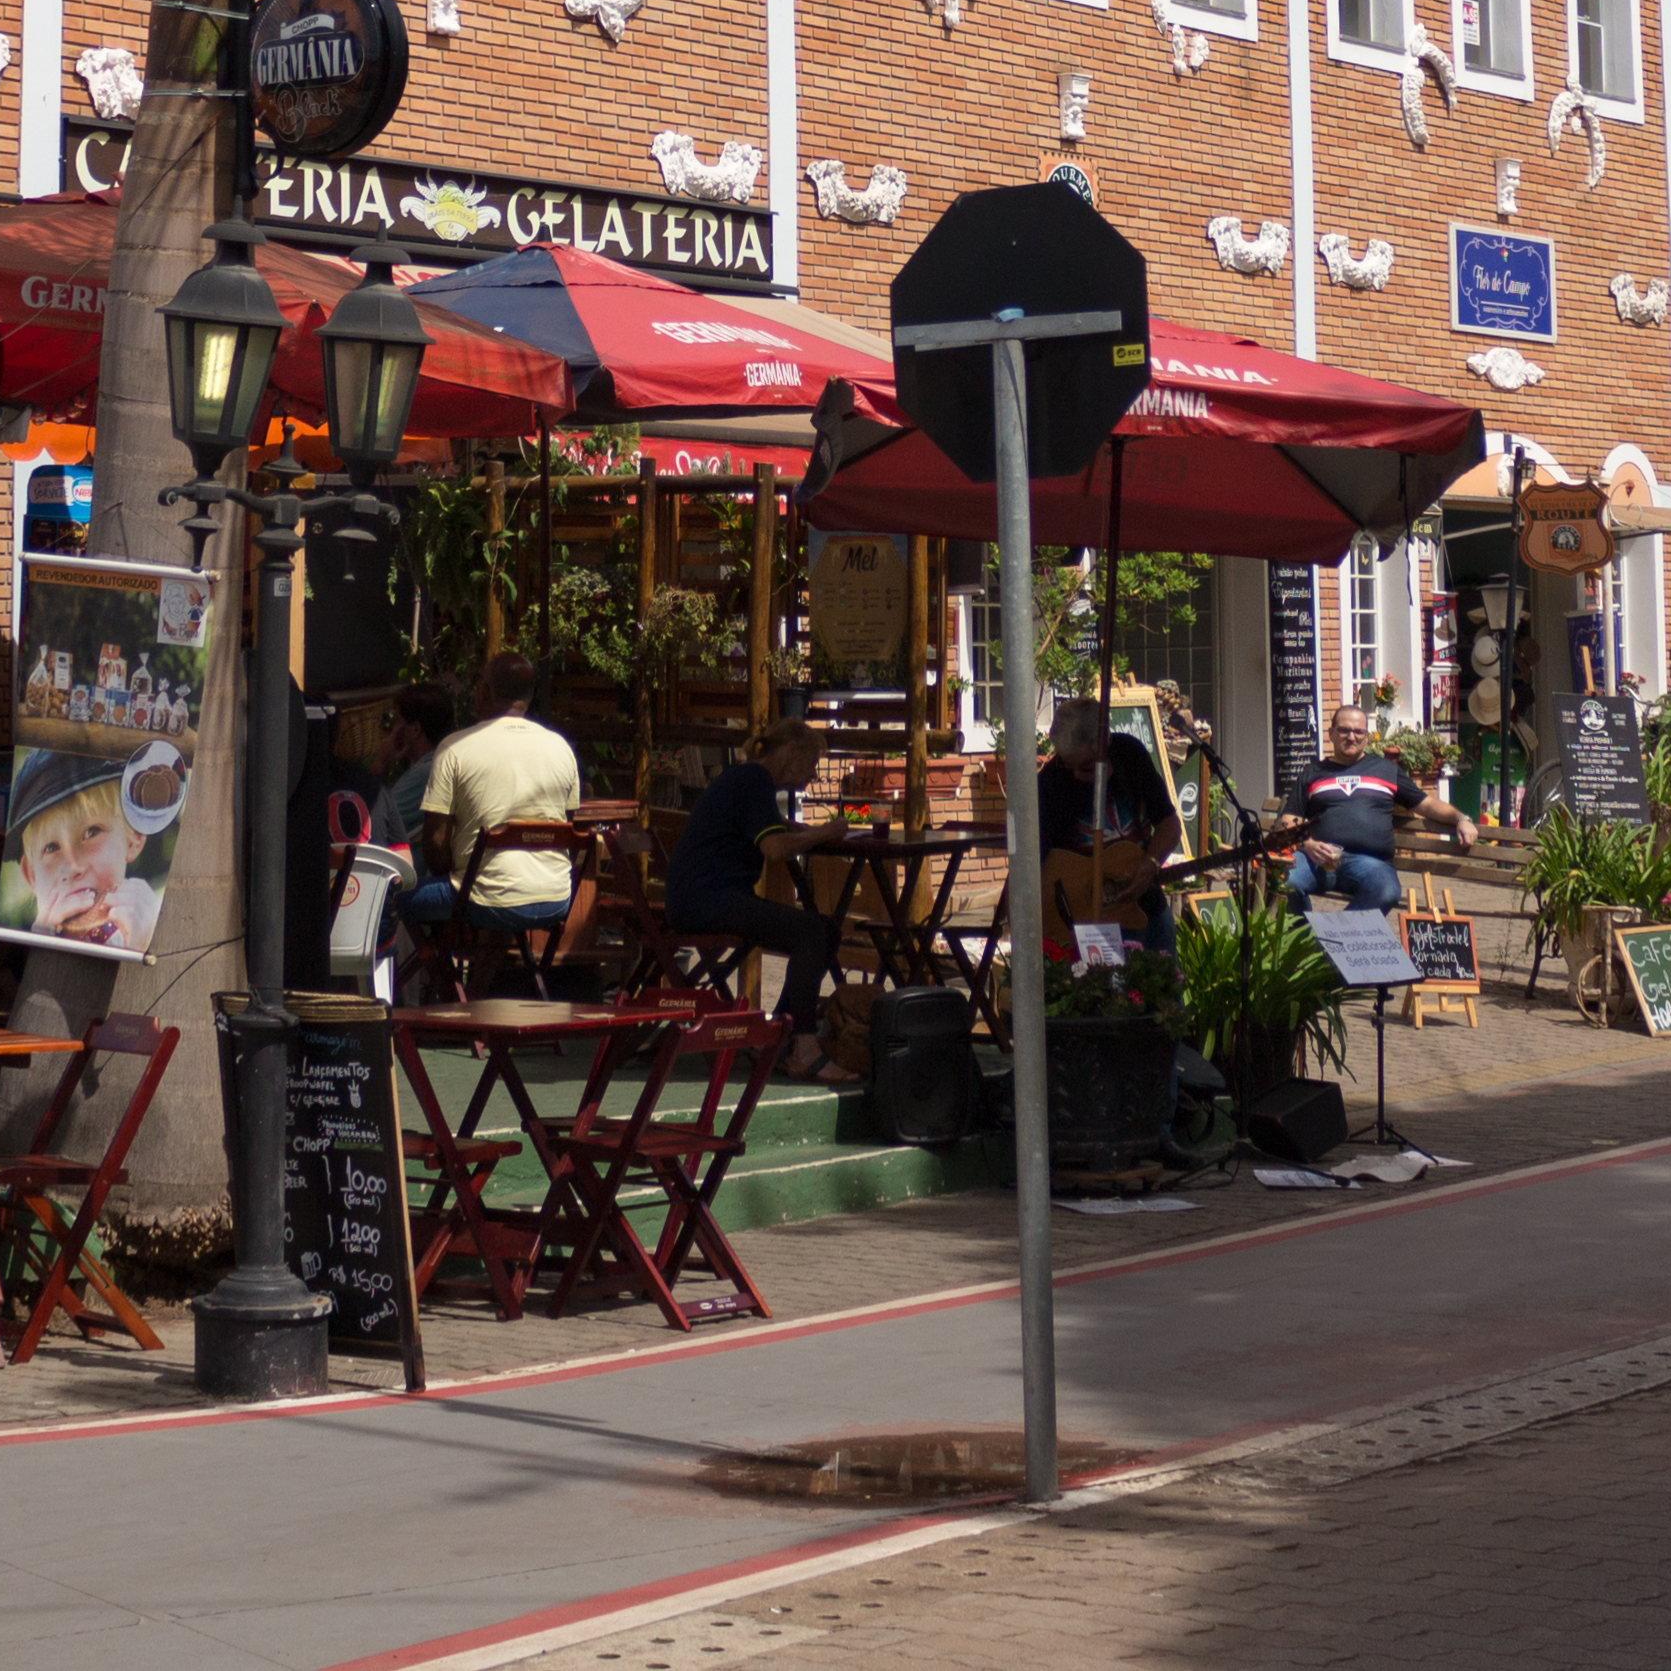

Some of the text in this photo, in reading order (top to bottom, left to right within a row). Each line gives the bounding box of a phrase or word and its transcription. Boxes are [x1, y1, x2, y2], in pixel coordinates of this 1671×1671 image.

[291, 16, 319, 34] CHOPP
[257, 36, 356, 86] GERMÂNIA
[274, 81, 342, 143] Black
[1052, 166, 1092, 206] OURME
[506, 187, 770, 273] GELATERIA
[745, 360, 802, 387] GERMÂNIA
[1536, 510, 1593, 519] ROUTE
[841, 544, 878, 573] Mel
[35, 569, 158, 590] REVENDEDOR AUTORIZADO
[1326, 939, 1401, 953] Sua colaboração
[1371, 955, 1399, 966] doada
[292, 1135, 331, 1152] CHOPP
[340, 1156, 386, 1194] 10,00
[351, 1269, 392, 1299] 15,00
